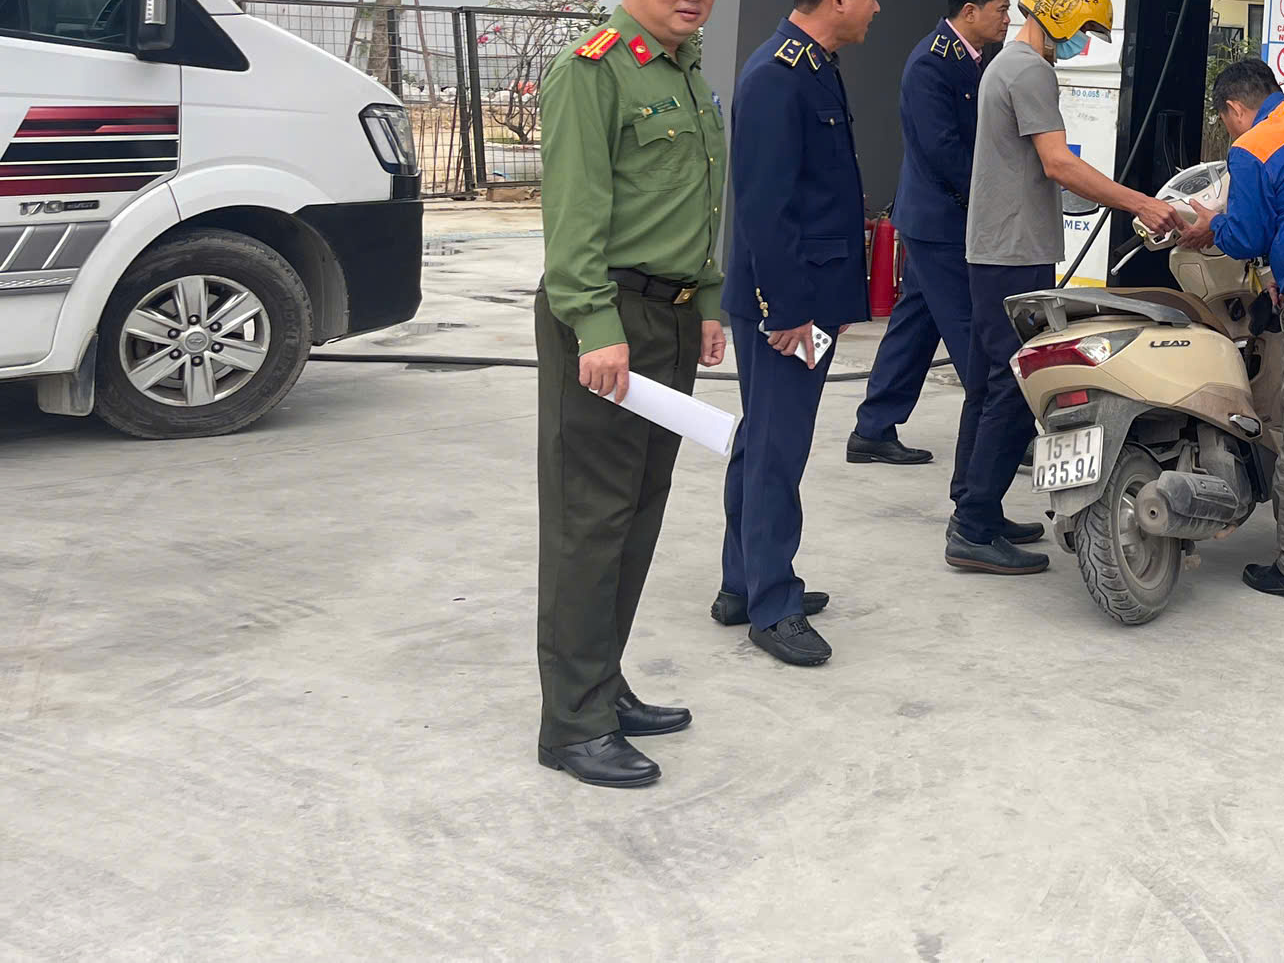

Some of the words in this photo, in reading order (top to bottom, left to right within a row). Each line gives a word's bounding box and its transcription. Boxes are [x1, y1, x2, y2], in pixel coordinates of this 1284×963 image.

[1150, 339, 1191, 349] LEAD
[1046, 431, 1091, 461] 15-L1
[1036, 455, 1096, 487] 035.94
